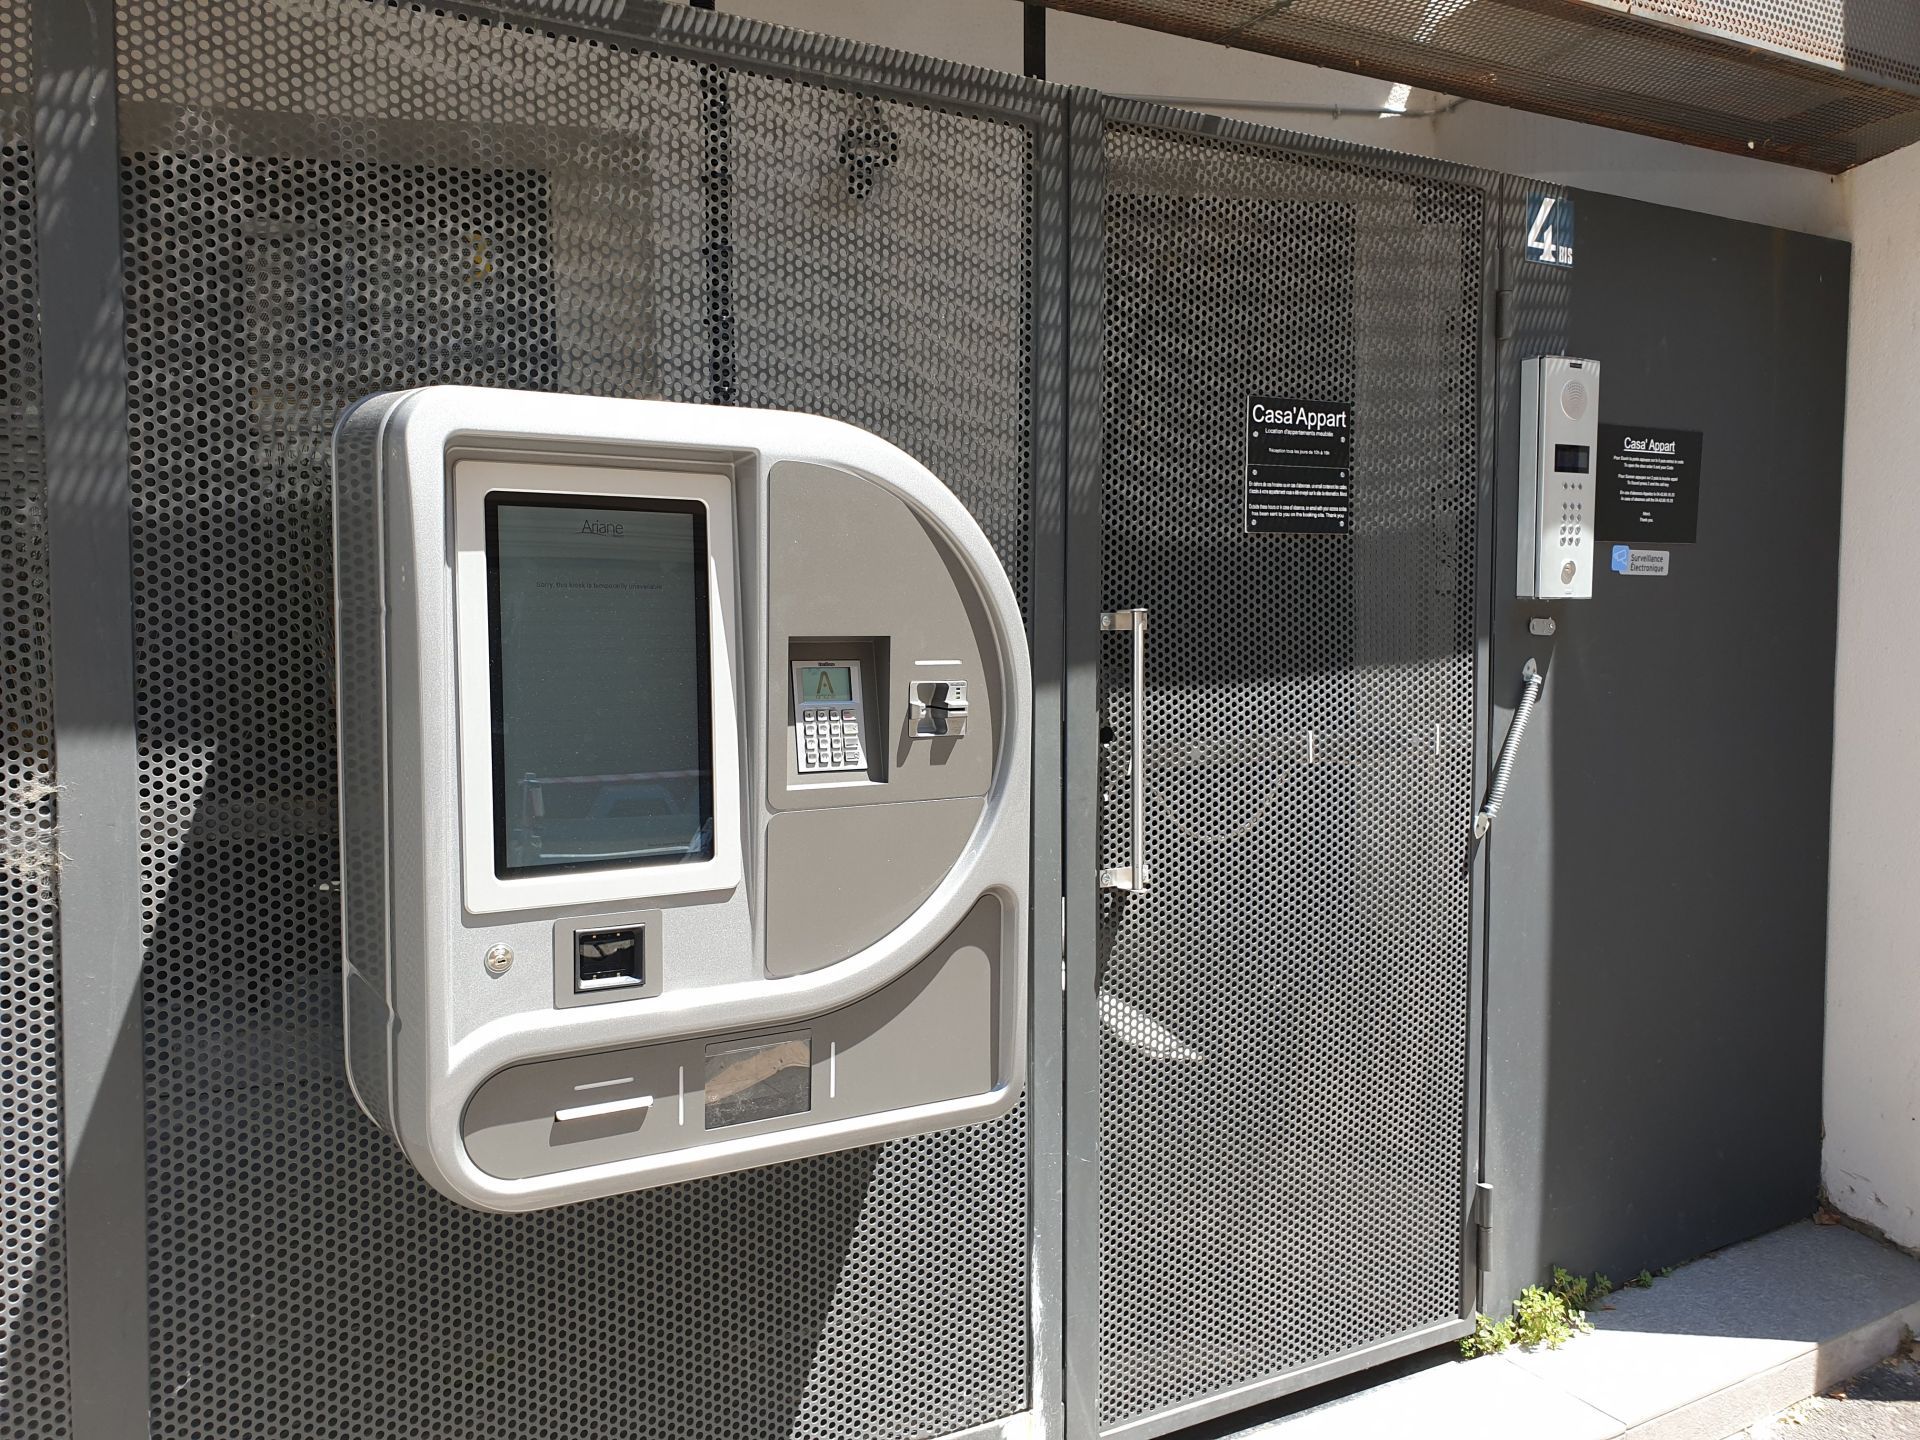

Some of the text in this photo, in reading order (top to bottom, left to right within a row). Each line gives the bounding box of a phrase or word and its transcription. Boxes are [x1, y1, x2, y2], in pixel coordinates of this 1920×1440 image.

[1527, 197, 1573, 264] 4 BIS
[1252, 404, 1346, 430] Casa'Appart
[582, 519, 623, 535] Ariane
